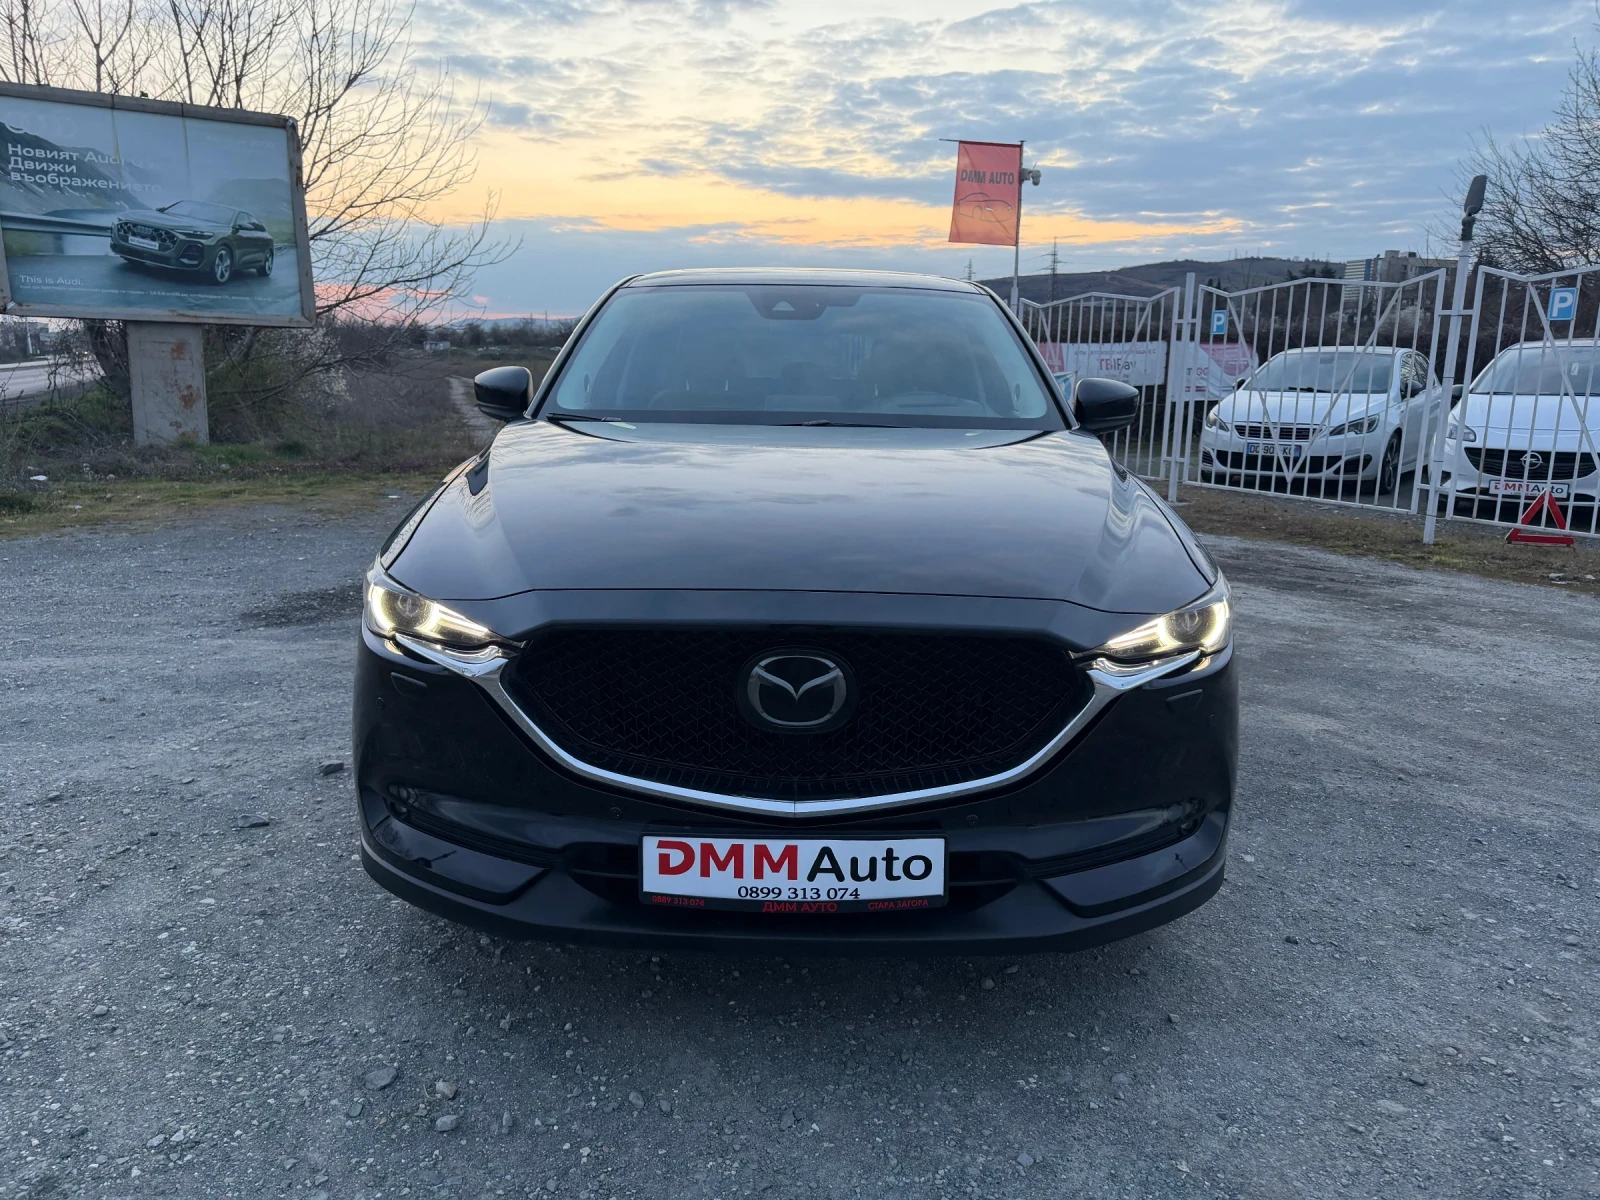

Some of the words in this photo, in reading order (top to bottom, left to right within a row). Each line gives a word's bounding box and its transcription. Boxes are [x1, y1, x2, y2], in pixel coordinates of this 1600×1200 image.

[8, 143, 79, 161] Новият
[8, 156, 77, 174] Движи
[961, 169, 986, 184] DMM
[989, 171, 1015, 185] AUTO
[19, 274, 42, 284] This
[45, 275, 54, 284] is
[57, 276, 84, 286] Audi.
[1552, 291, 1573, 317] P
[1213, 312, 1225, 332] P
[656, 839, 799, 881] DMM
[806, 846, 933, 883] Auto
[737, 885, 782, 900] 0899
[787, 887, 821, 900] 313
[826, 887, 860, 900] 074
[673, 896, 688, 906] 313
[690, 898, 705, 907] 074
[763, 902, 797, 913] ДММ
[801, 902, 838, 913] АУТО
[867, 901, 895, 910] СТАРА
[896, 899, 929, 909] ЗАГОРА
